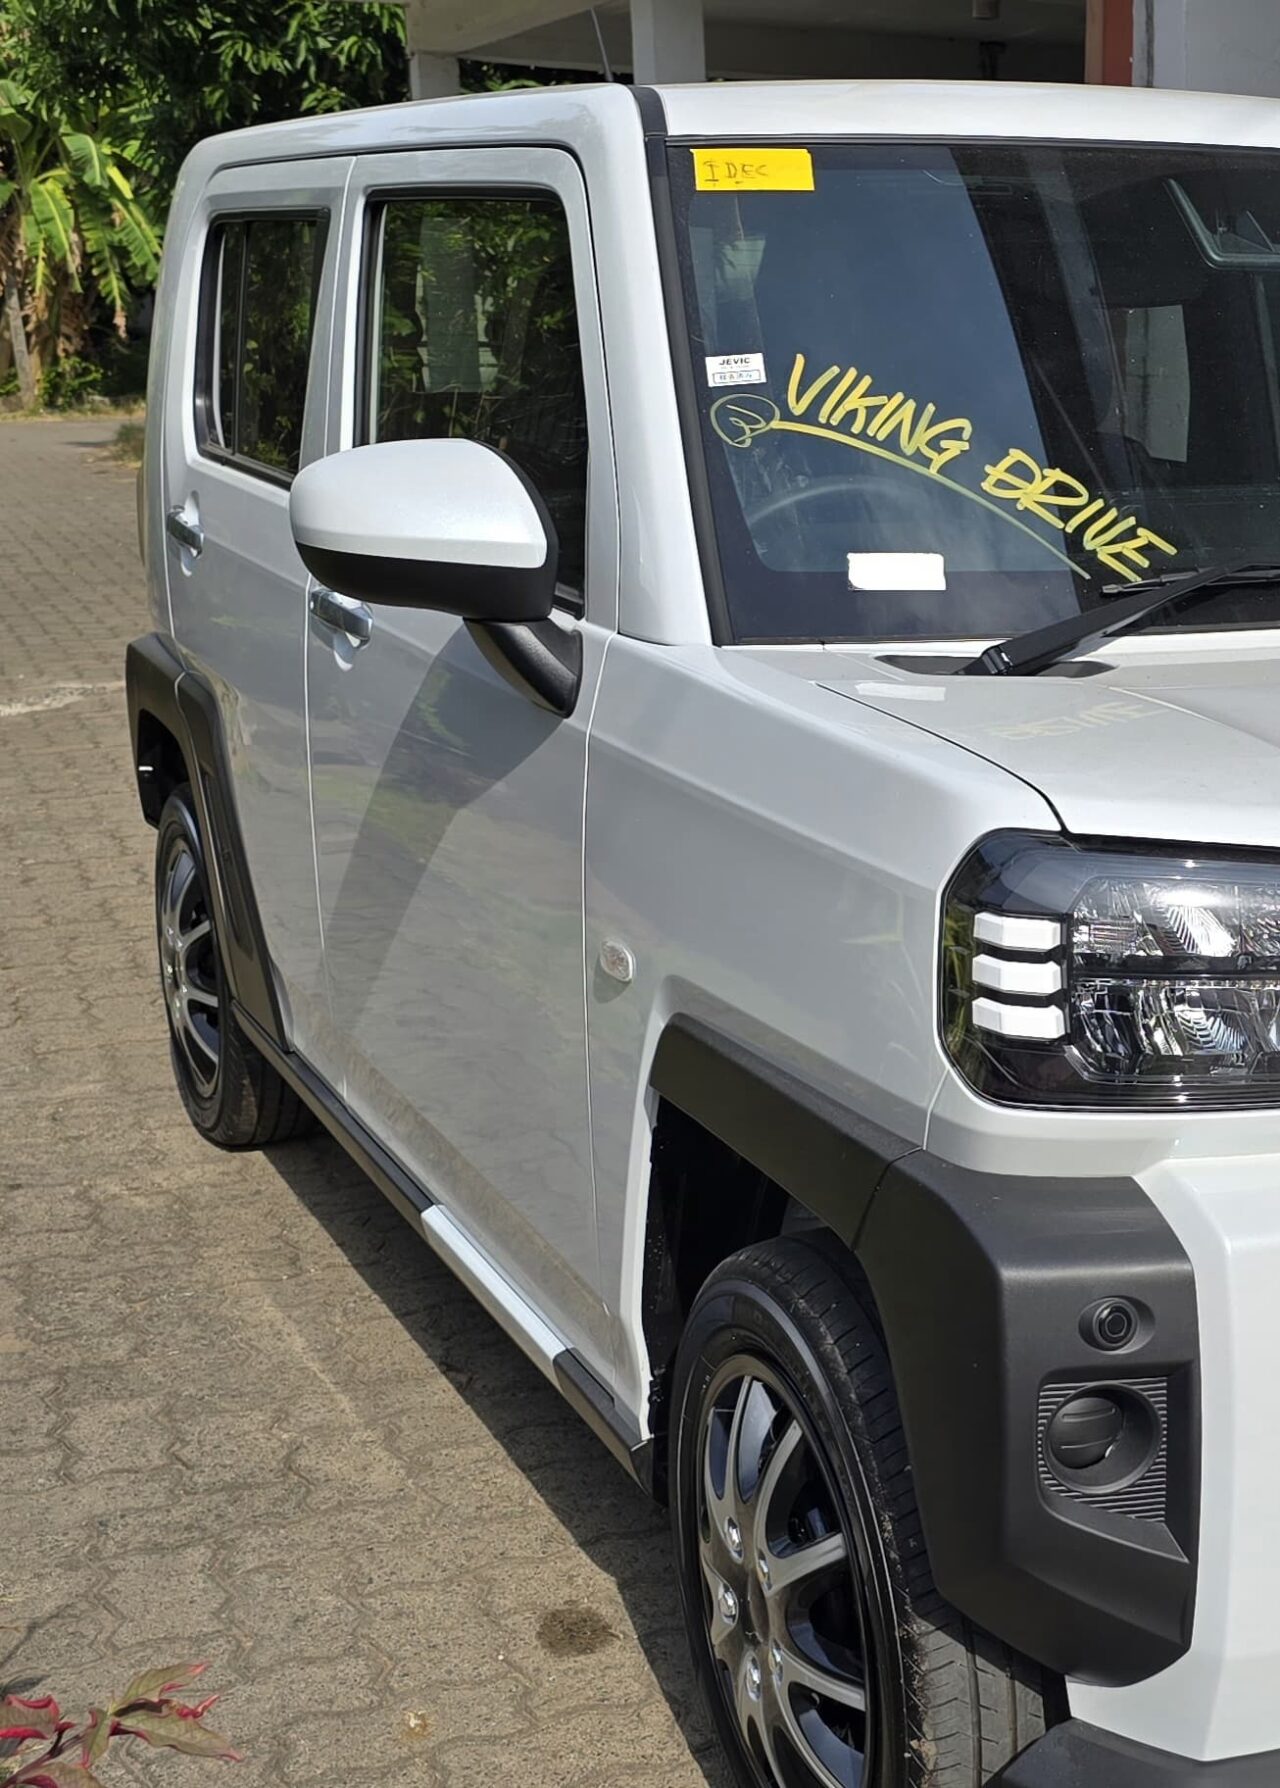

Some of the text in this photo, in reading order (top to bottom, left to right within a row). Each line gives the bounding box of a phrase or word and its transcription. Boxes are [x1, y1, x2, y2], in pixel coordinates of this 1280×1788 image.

[719, 357, 751, 366] JEVIC
[787, 353, 1178, 583] VIKING DRIVE
